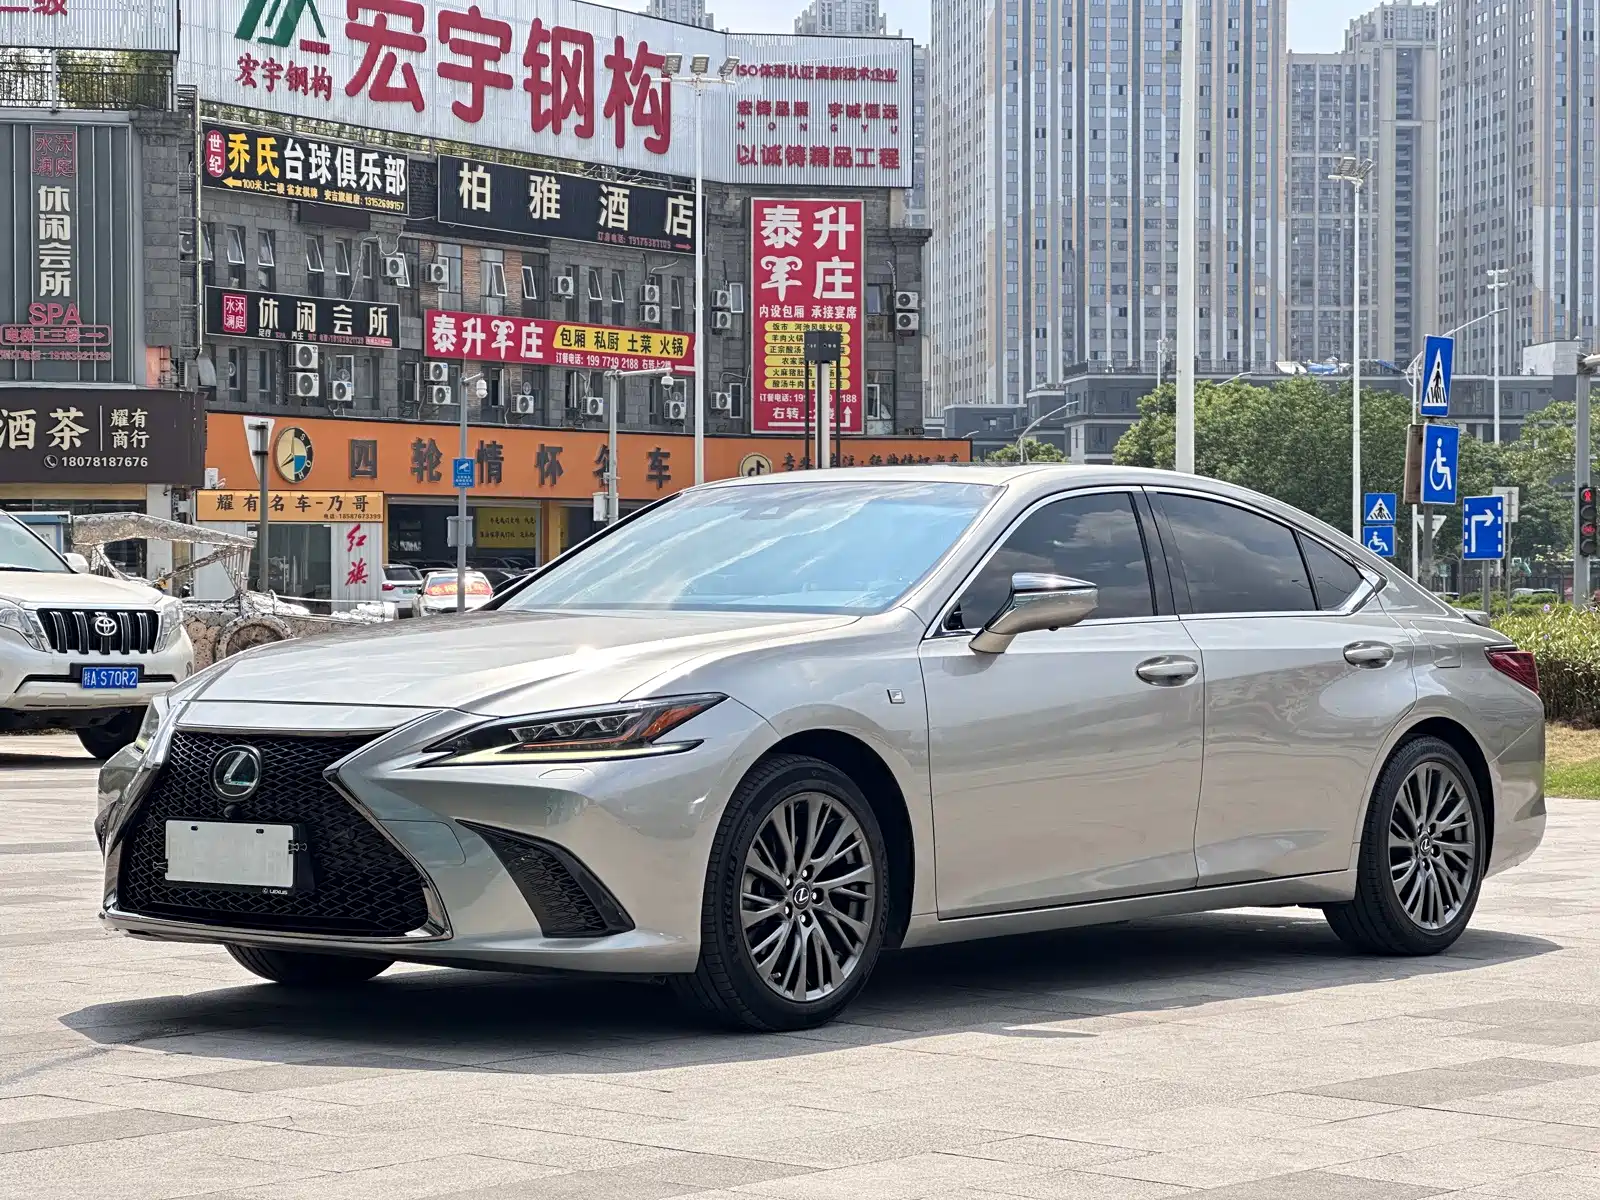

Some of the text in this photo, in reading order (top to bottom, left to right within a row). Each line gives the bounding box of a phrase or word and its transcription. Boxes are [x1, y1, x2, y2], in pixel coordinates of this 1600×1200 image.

[235, 53, 333, 101] 宏宇钢构
[345, 0, 671, 154] 宏宇钢构
[208, 134, 223, 174] 世纪
[228, 133, 406, 196] 乔氏台球俱乐部
[736, 144, 900, 169] 以诚铸精品工程
[459, 162, 694, 239] 柏雅酒店
[760, 205, 855, 250] 泰升
[38, 185, 71, 297] 休闲会所
[29, 303, 82, 326] SPA
[226, 299, 244, 313] 水沐
[259, 297, 388, 336] 休闲会所
[760, 305, 857, 319] 内设包厢 承接宴席
[5, 327, 80, 342] 电梯上三楼
[226, 315, 244, 330] 澜庭
[560, 327, 683, 357] 包厢 私厨 土菜 火锅
[770, 345, 805, 354] 正宗酸汤
[772, 334, 804, 342] 羊肉火锅
[556, 352, 584, 365] 订餐电话:
[587, 355, 600, 366] 199
[602, 356, 619, 368] 7719
[621, 358, 639, 369] 2188
[772, 380, 804, 388] 酸汤牛肉
[0, 407, 90, 451] 酒茶
[110, 409, 149, 428] 耀有
[111, 429, 150, 449] 商行
[61, 456, 148, 467] 18078187676
[345, 523, 369, 586] 红旗
